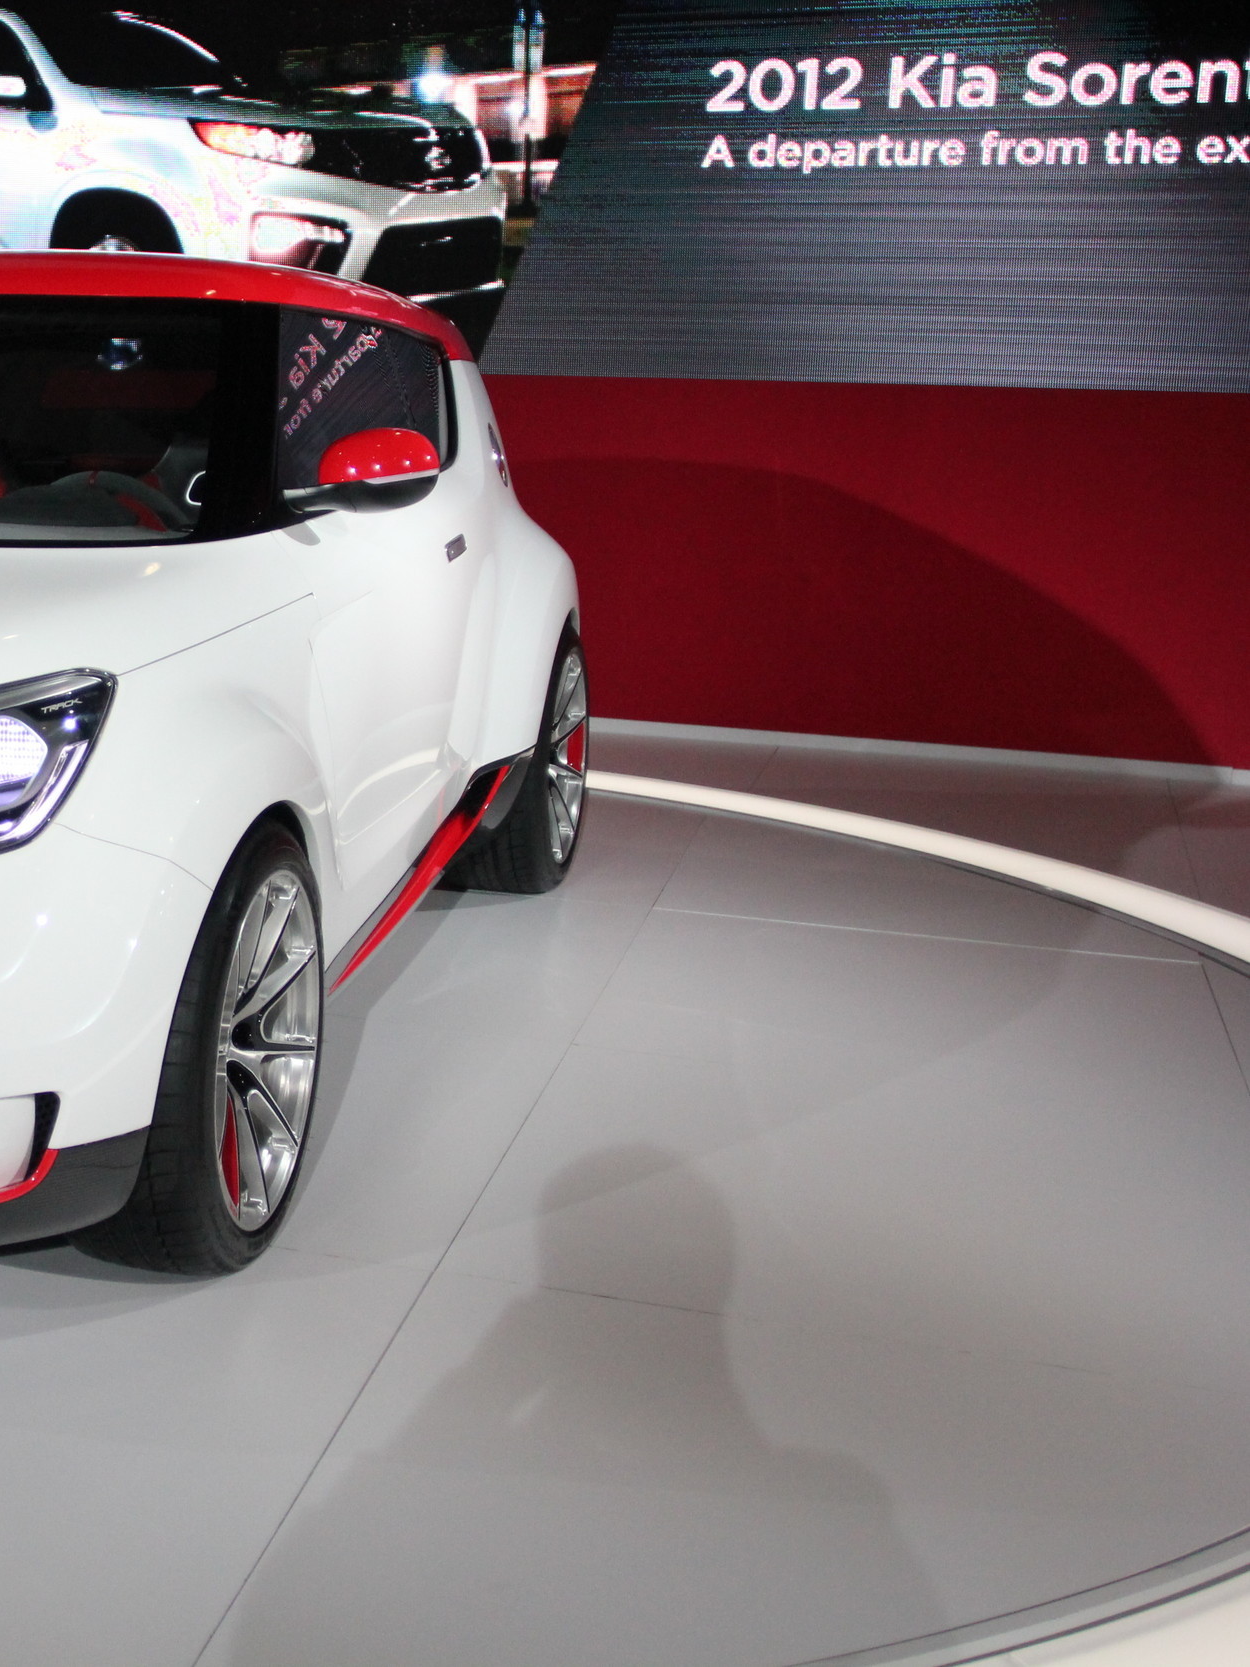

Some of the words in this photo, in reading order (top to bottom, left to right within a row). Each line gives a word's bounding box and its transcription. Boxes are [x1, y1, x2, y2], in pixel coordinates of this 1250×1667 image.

[706, 56, 863, 112] 2012
[888, 52, 998, 109] Kia
[701, 135, 735, 168] A
[748, 133, 966, 174] departure
[981, 130, 1089, 165] from
[1105, 129, 1182, 165] the
[40, 698, 83, 714] TRACK
